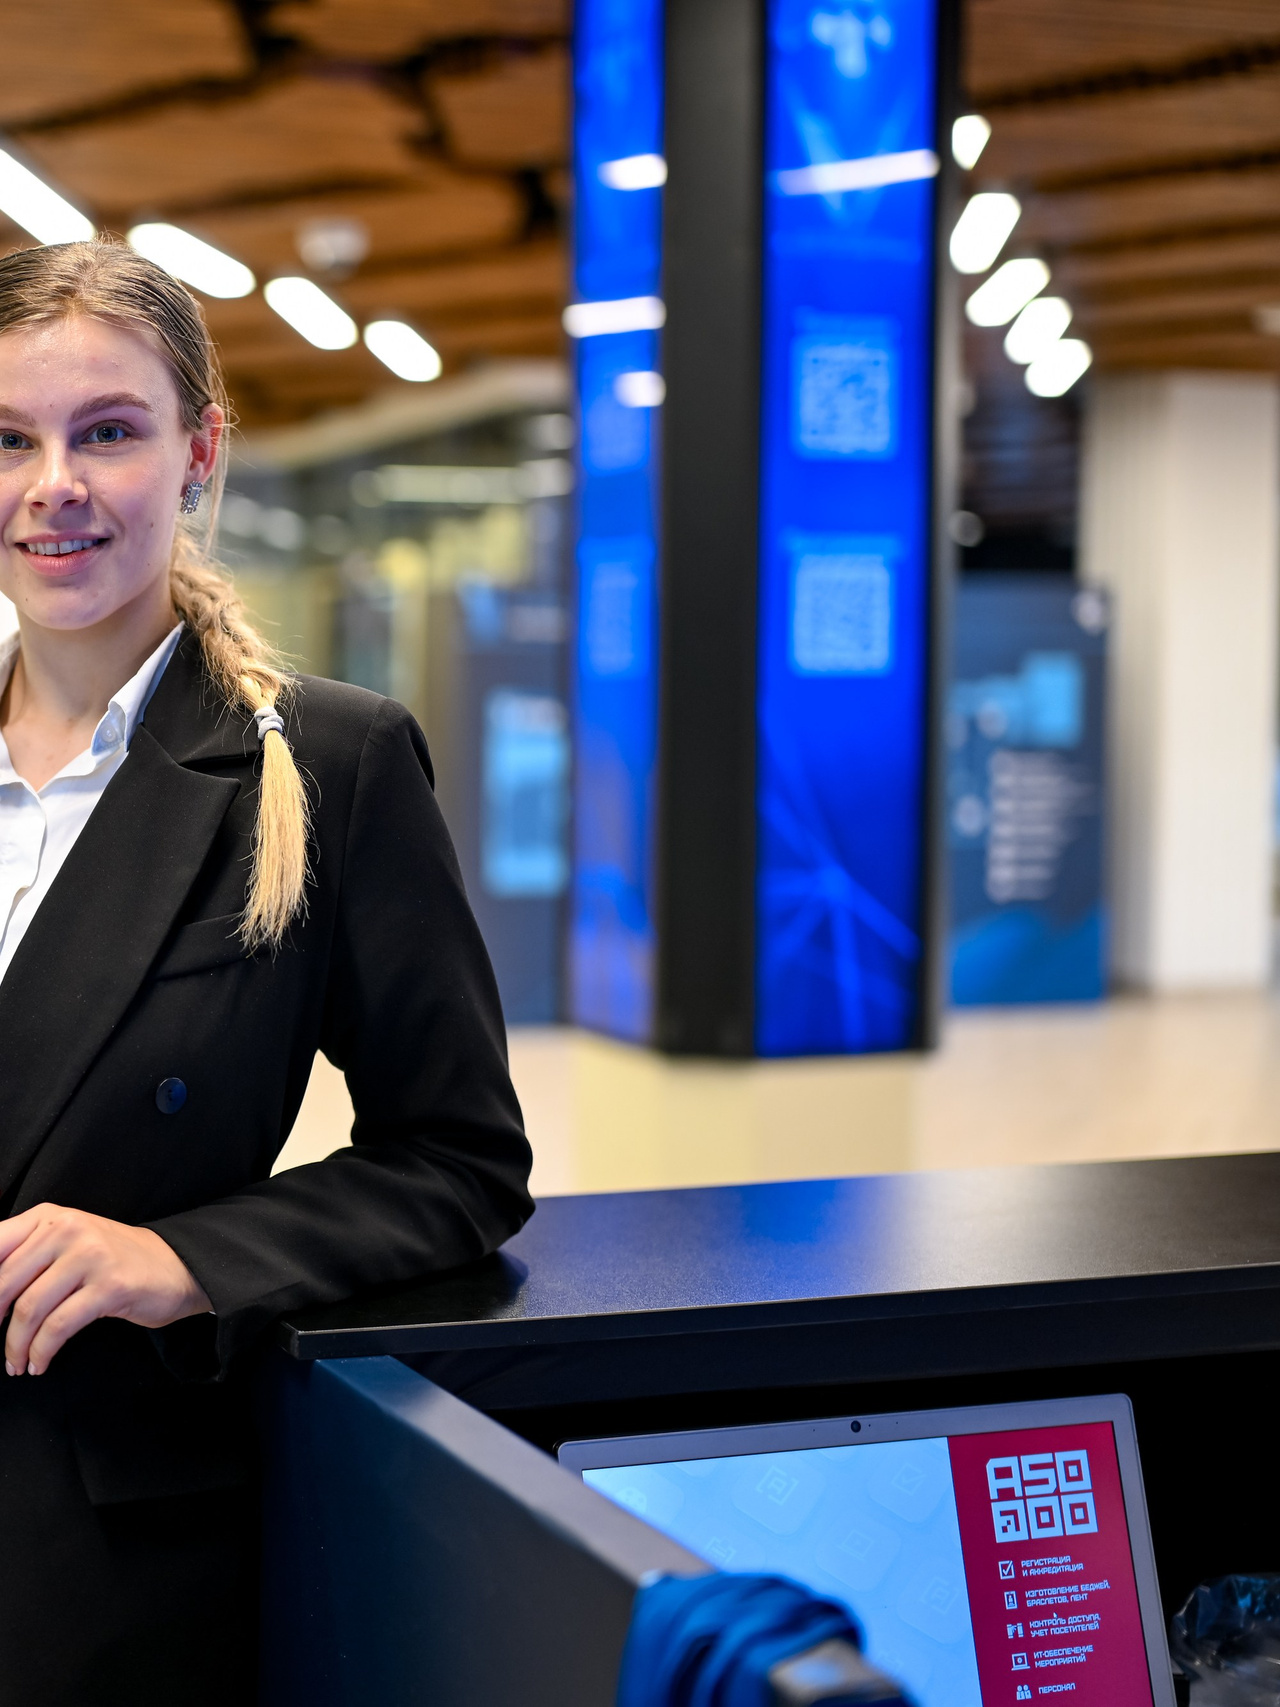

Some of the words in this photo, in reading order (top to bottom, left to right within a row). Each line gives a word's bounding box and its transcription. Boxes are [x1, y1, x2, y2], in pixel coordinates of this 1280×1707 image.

[1021, 1555, 1071, 1568] РЕГИСТРАЦИЯ
[1022, 1569, 1028, 1577] И
[1029, 1563, 1084, 1576] АККРЕДИТАЦИЯ
[1025, 1585, 1079, 1598] ИЗГОТОВЛЕНИЕ
[1026, 1595, 1069, 1607] БРАСЛЕТОВ,
[1070, 1593, 1088, 1602] ЛЕНТ
[1029, 1617, 1066, 1629] КОНТРОЛЬ
[1067, 1613, 1101, 1625] ДОСТУПА,
[1030, 1628, 1049, 1638] УЧЕТ
[1050, 1621, 1099, 1635] ПОСЕТИТЕЛЕЙ
[1033, 1644, 1094, 1659] ИТ-ОБЕСПЕЧЕНИЕ
[1035, 1653, 1086, 1668] МЕРОПРИЯТИЙ
[1038, 1682, 1076, 1695] ПЕРСОНАЛ
